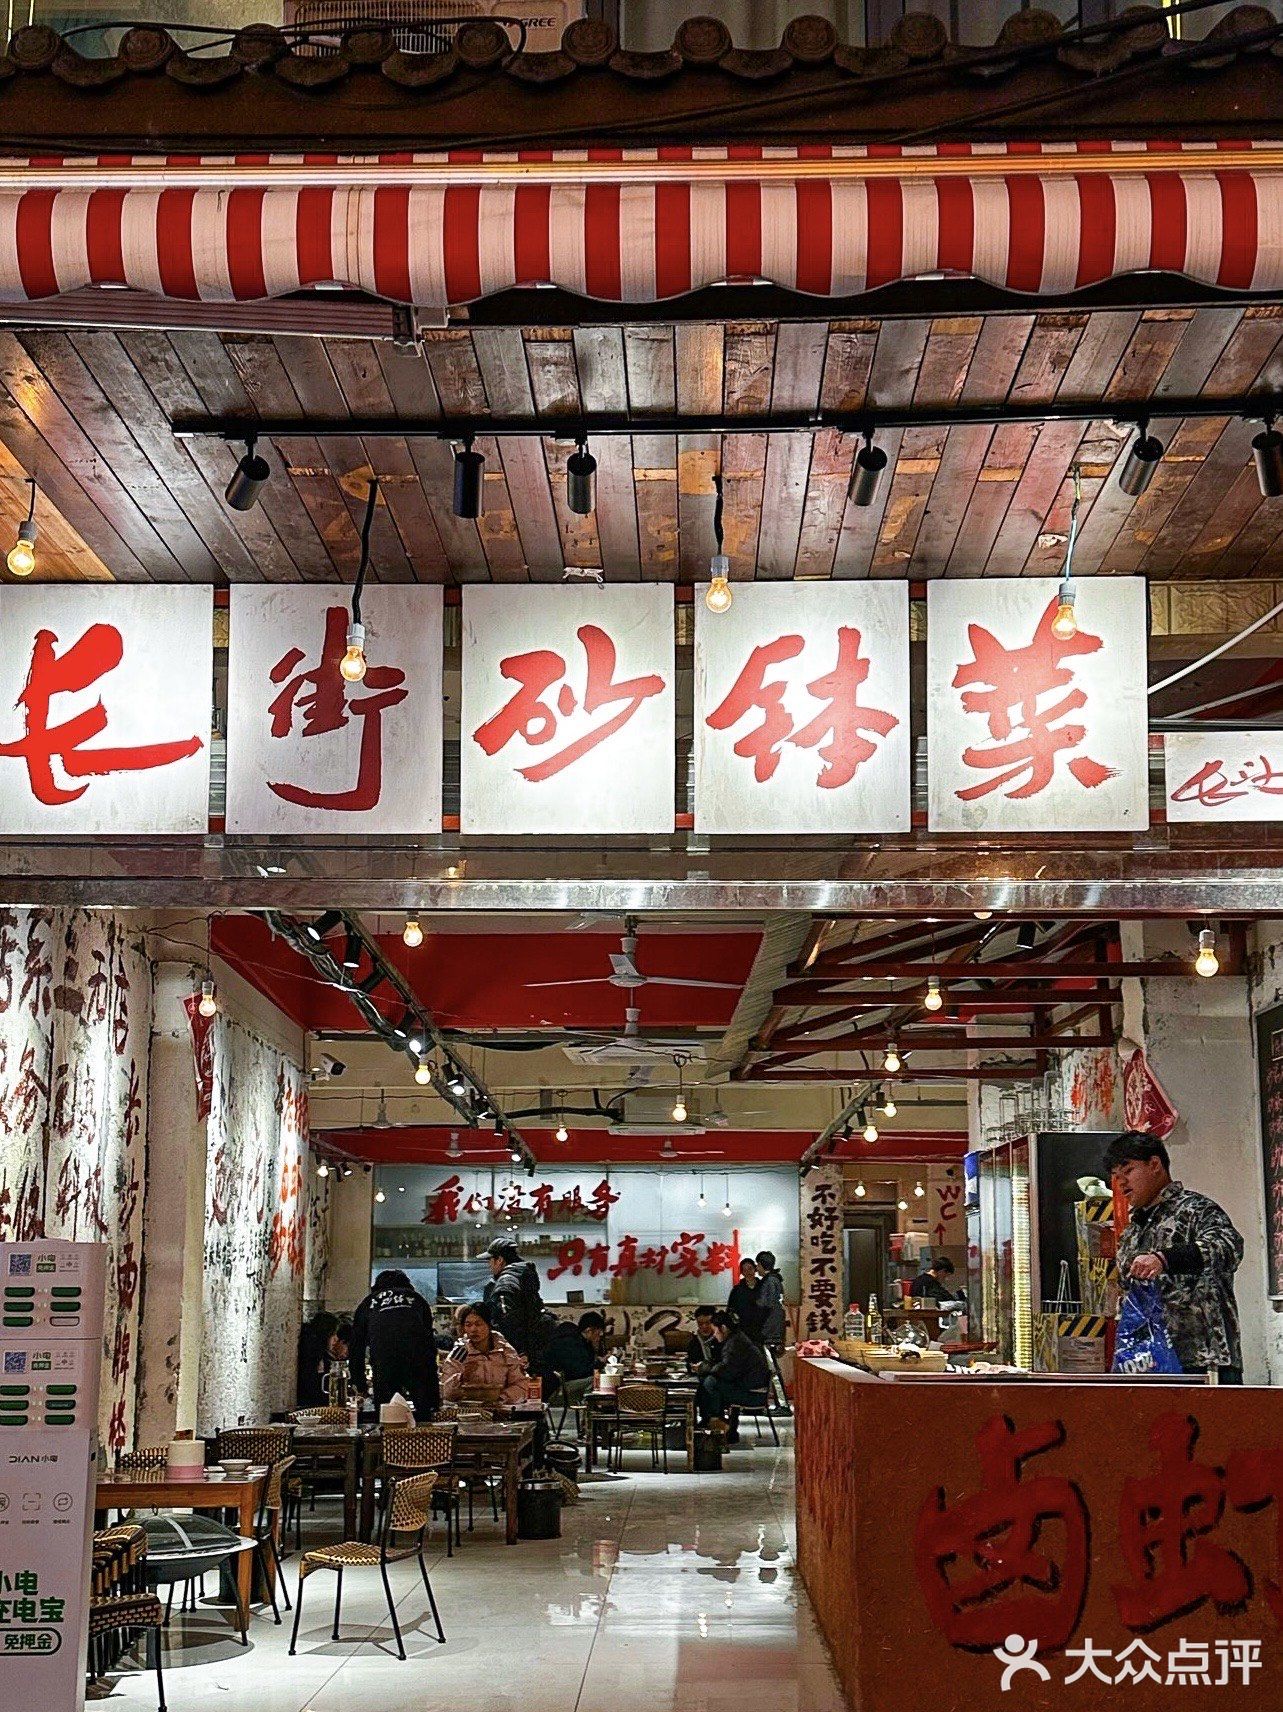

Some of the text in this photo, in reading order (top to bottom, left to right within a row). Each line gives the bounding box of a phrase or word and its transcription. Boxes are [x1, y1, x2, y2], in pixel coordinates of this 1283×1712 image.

[522, 18, 556, 27] GREE
[421, 1174, 621, 1225] 我们没有服务
[937, 1185, 961, 1221] WC
[547, 1229, 742, 1286] 只有真材实料
[806, 1183, 840, 1335] 不好吃不要钱
[4, 1633, 52, 1650] 免押金
